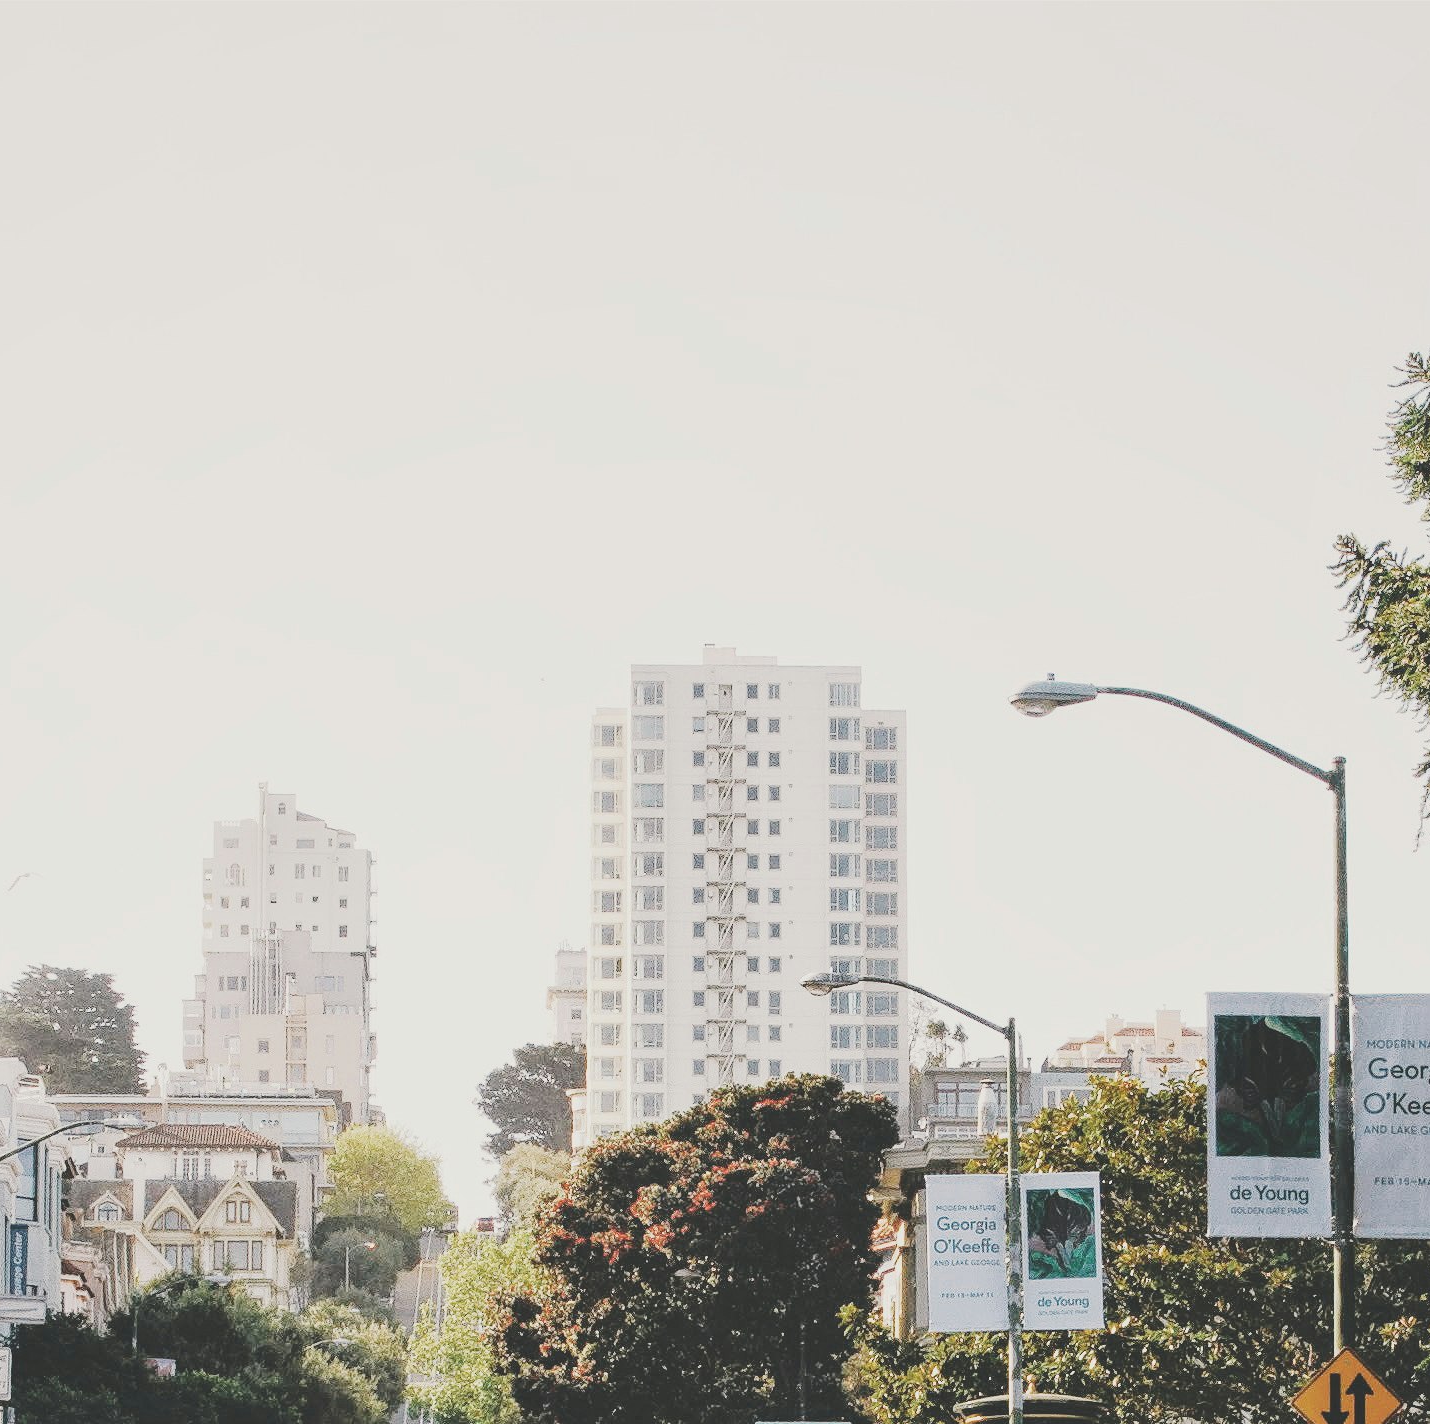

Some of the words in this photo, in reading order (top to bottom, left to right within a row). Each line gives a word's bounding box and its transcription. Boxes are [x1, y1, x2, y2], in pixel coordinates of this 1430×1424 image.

[1366, 1039, 1415, 1049] MODERN
[1364, 1125, 1387, 1134] AND
[1391, 1125, 1417, 1135] LAKE
[1374, 1176, 1394, 1186] FEB
[1230, 1185, 1252, 1201] de
[1255, 1184, 1309, 1205] Young
[1231, 1206, 1264, 1215] GOLDEN
[1266, 1207, 1287, 1215] GATE
[1288, 1207, 1309, 1215] PARK
[937, 1216, 997, 1234] Georgia
[933, 1238, 1000, 1254] O'Keeffe
[1037, 1296, 1052, 1307] de
[1053, 1296, 1089, 1309] Young
